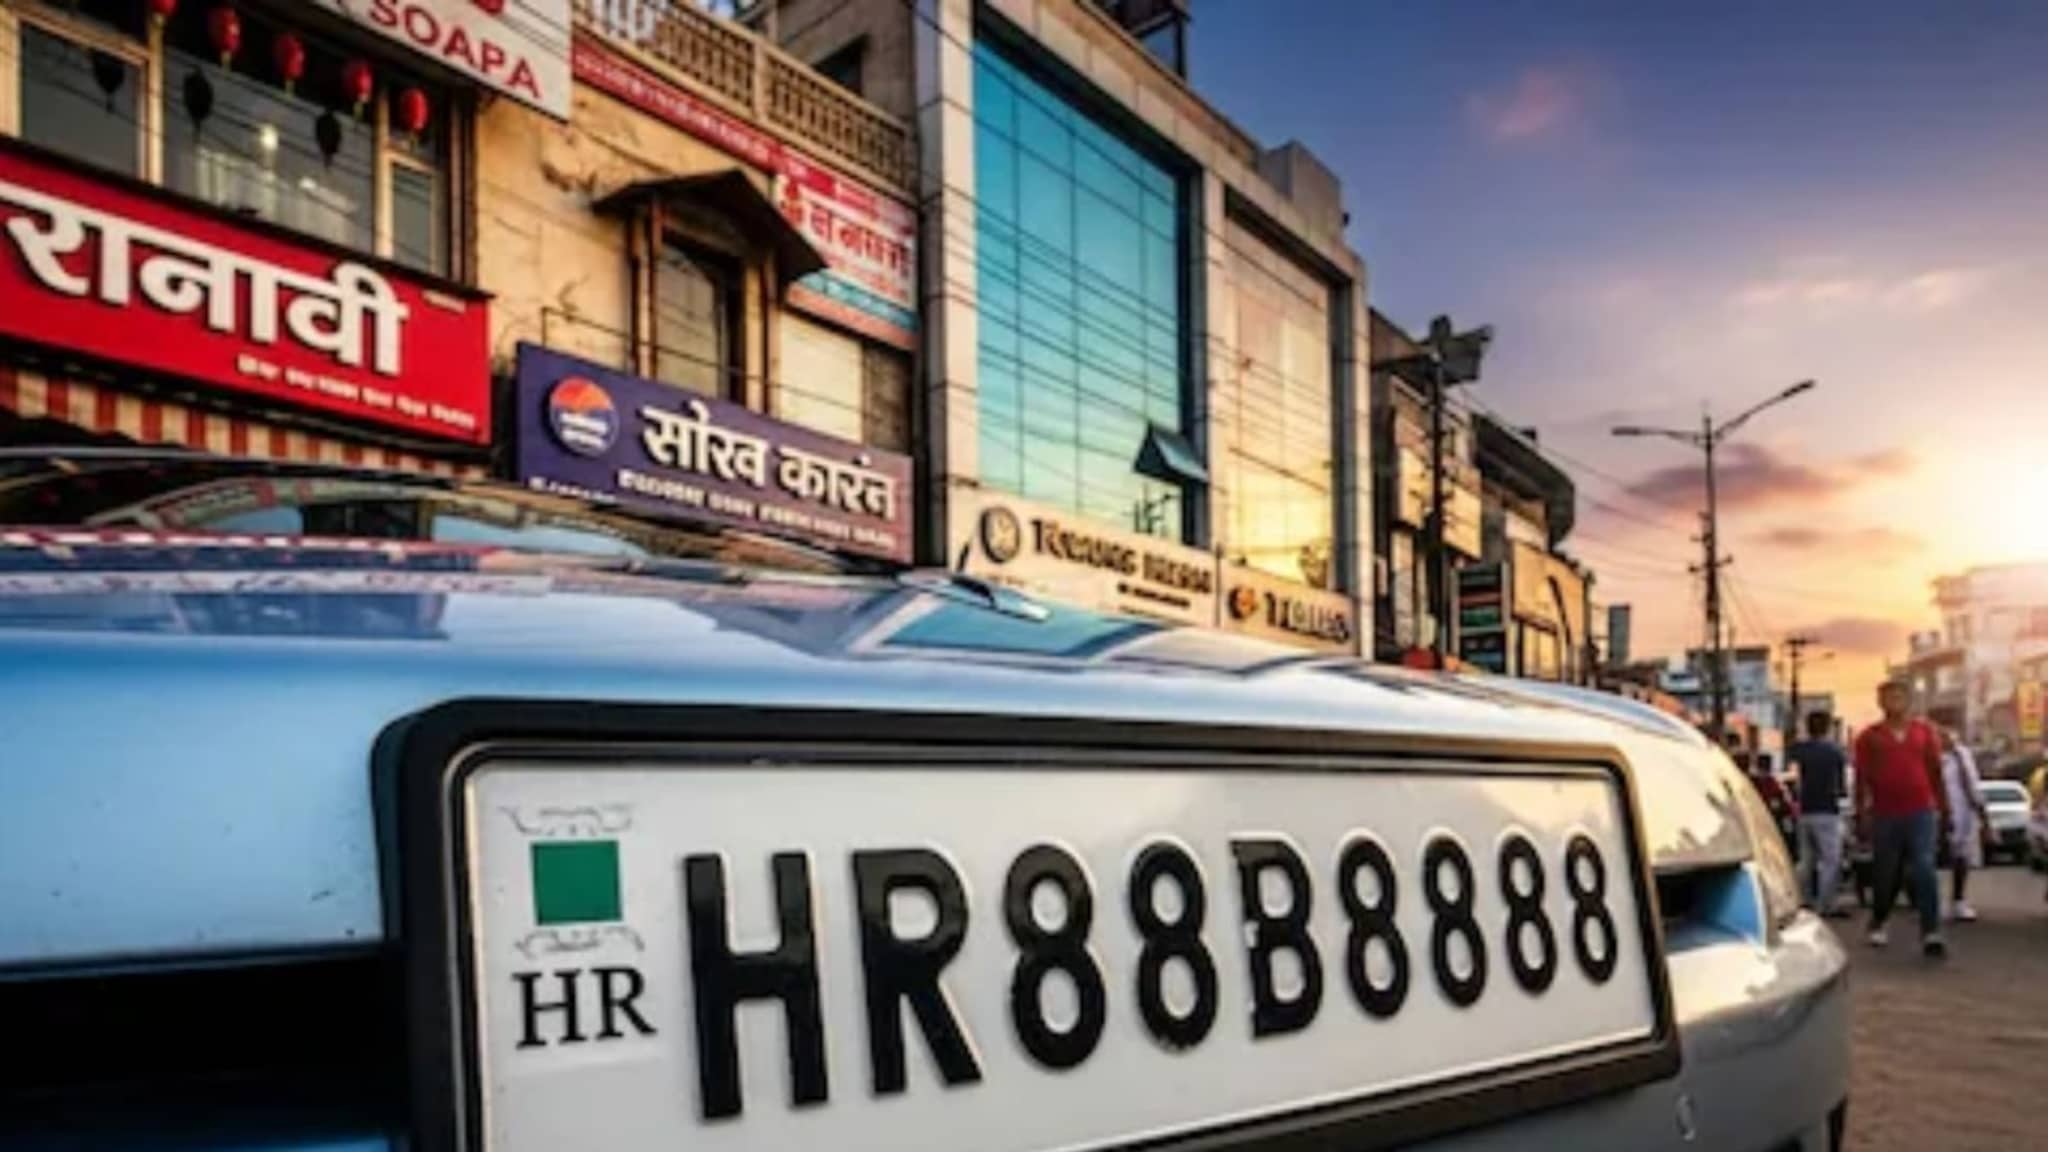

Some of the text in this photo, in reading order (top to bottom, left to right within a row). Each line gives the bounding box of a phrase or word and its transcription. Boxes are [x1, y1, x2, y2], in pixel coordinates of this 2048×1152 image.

[368, 0, 542, 99] SOAPA
[0, 181, 411, 376] रानावी
[511, 965, 658, 1050] HR
[682, 834, 1618, 1121] HR88B8888
